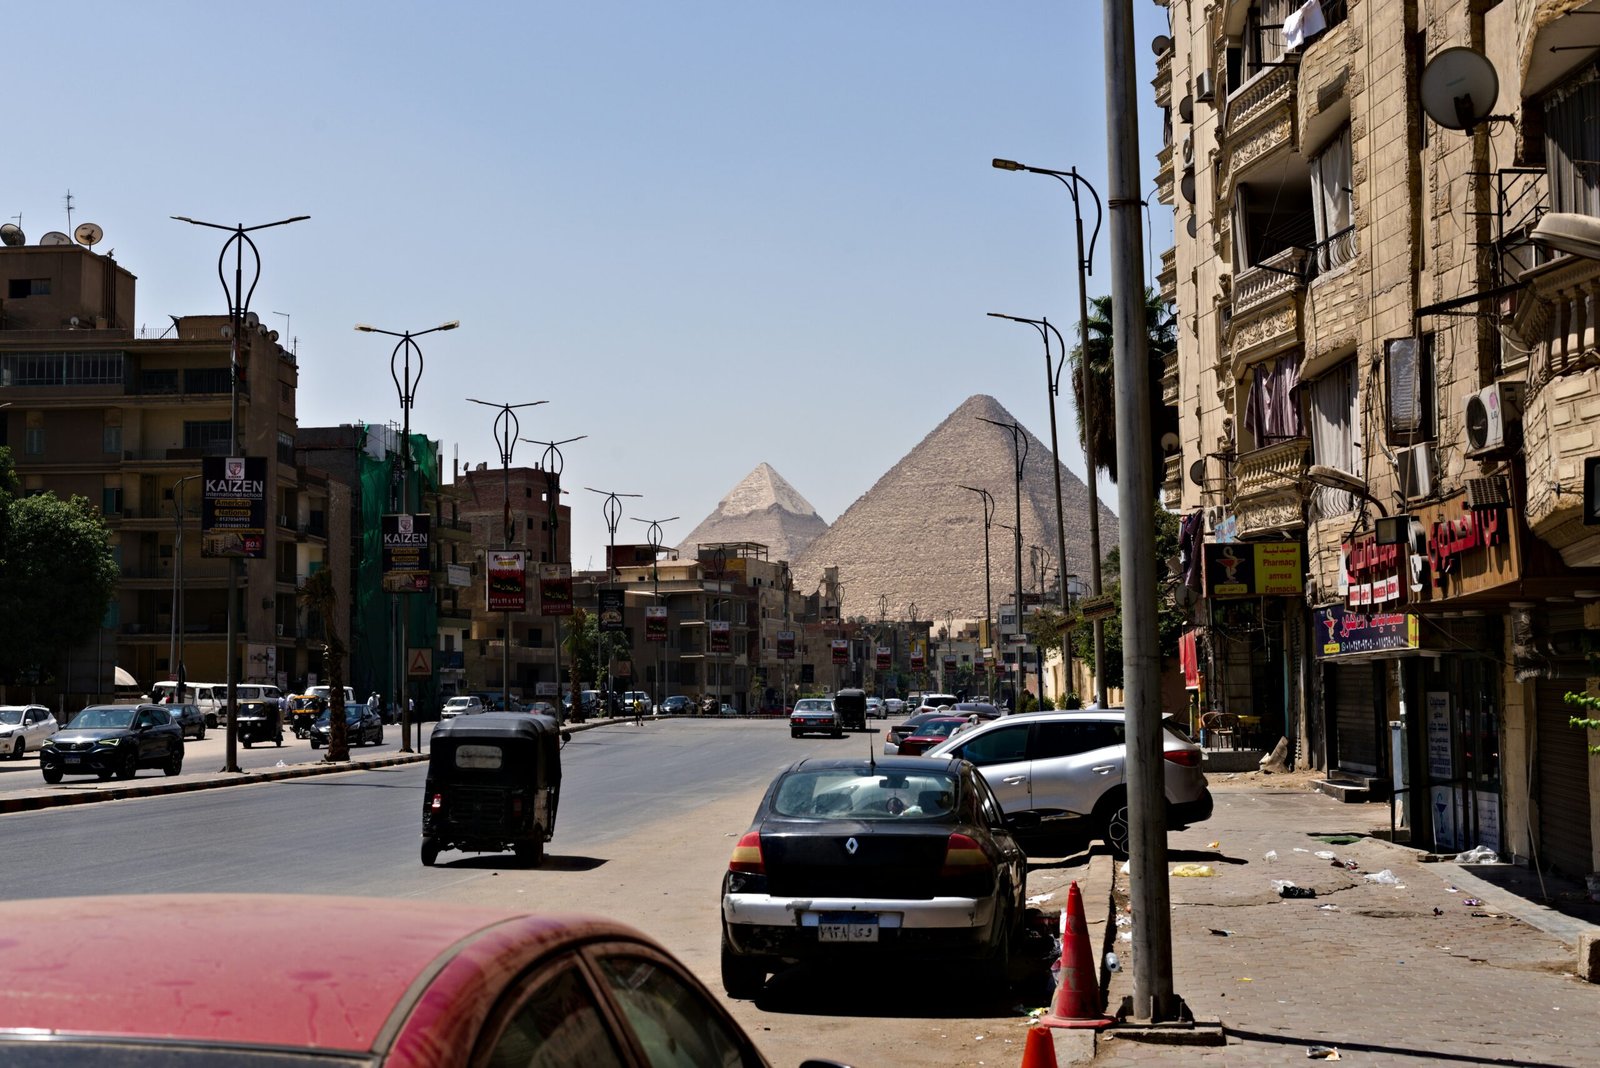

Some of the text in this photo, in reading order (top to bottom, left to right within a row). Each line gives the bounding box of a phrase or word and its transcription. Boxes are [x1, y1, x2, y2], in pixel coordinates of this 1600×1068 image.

[1491, 411, 1498, 419] LG
[206, 480, 263, 492] KAIZEN
[383, 533, 428, 543] KAIZEN
[1263, 559, 1296, 567] Pharmacy
[1265, 585, 1297, 593] Farmacia
